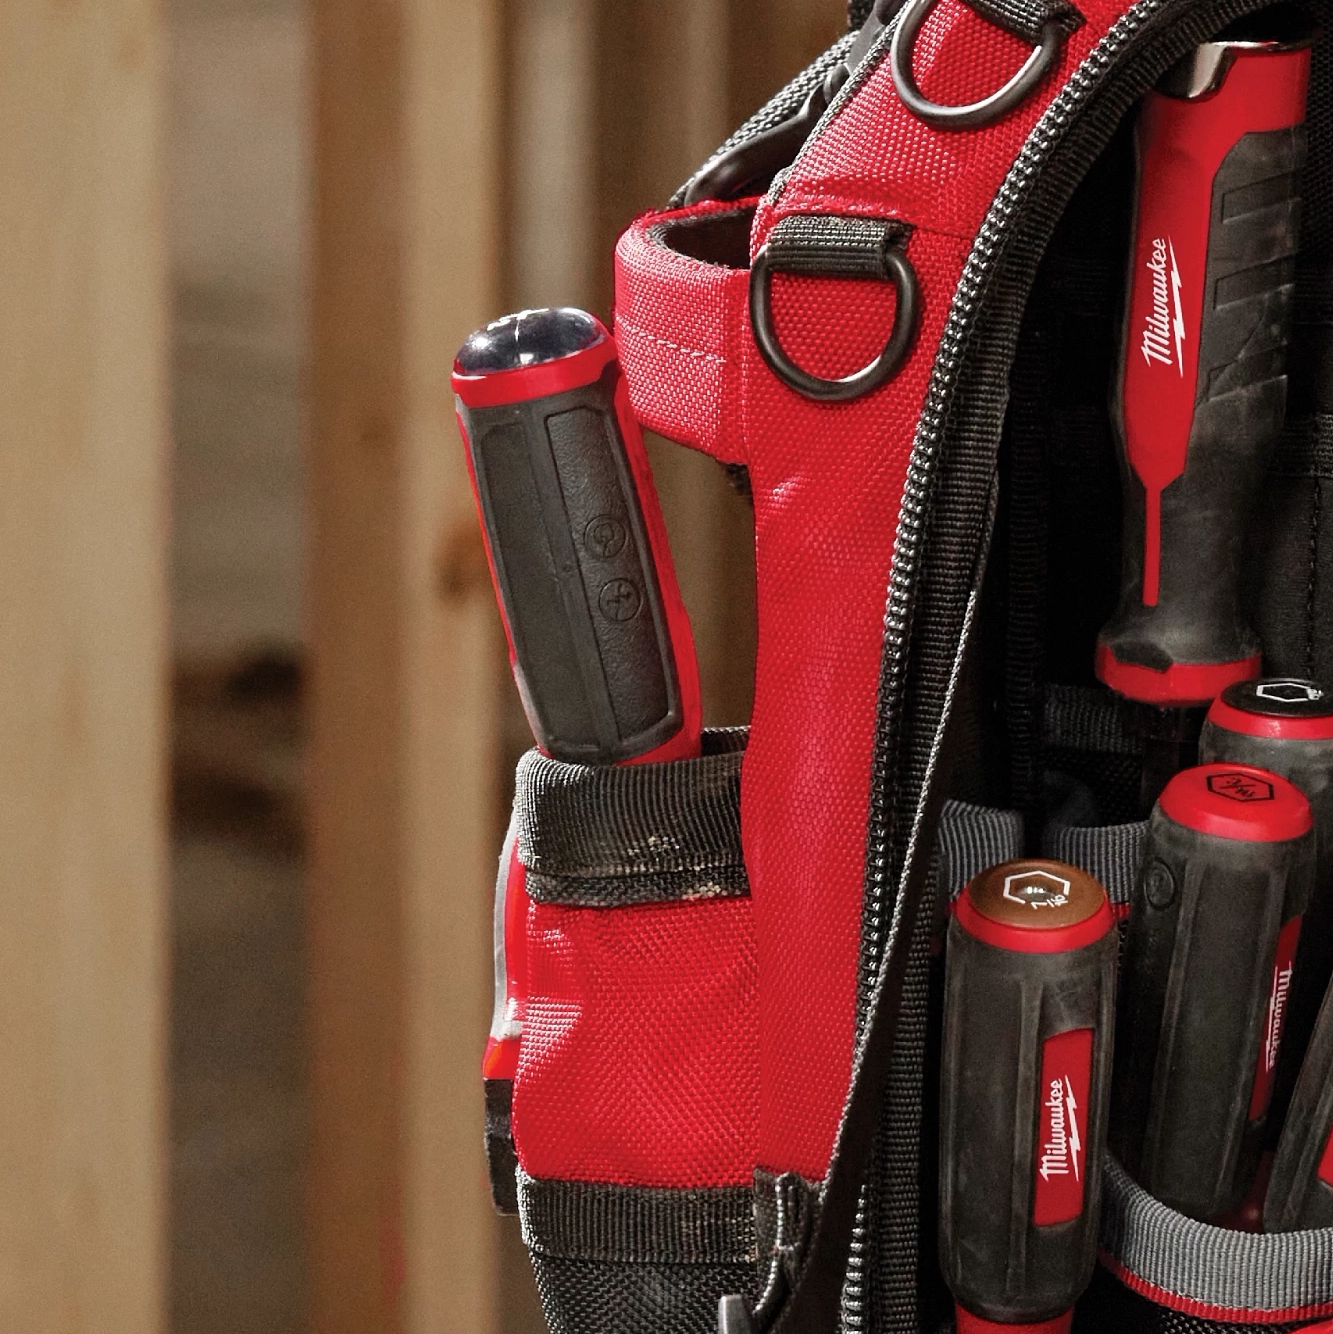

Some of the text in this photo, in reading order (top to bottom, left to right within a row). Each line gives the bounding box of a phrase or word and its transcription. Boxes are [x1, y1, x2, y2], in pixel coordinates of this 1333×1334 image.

[1141, 237, 1173, 367] Milwaukee
[1268, 960, 1293, 1069] Milwaukee
[1039, 1078, 1069, 1182] Milwaukee
